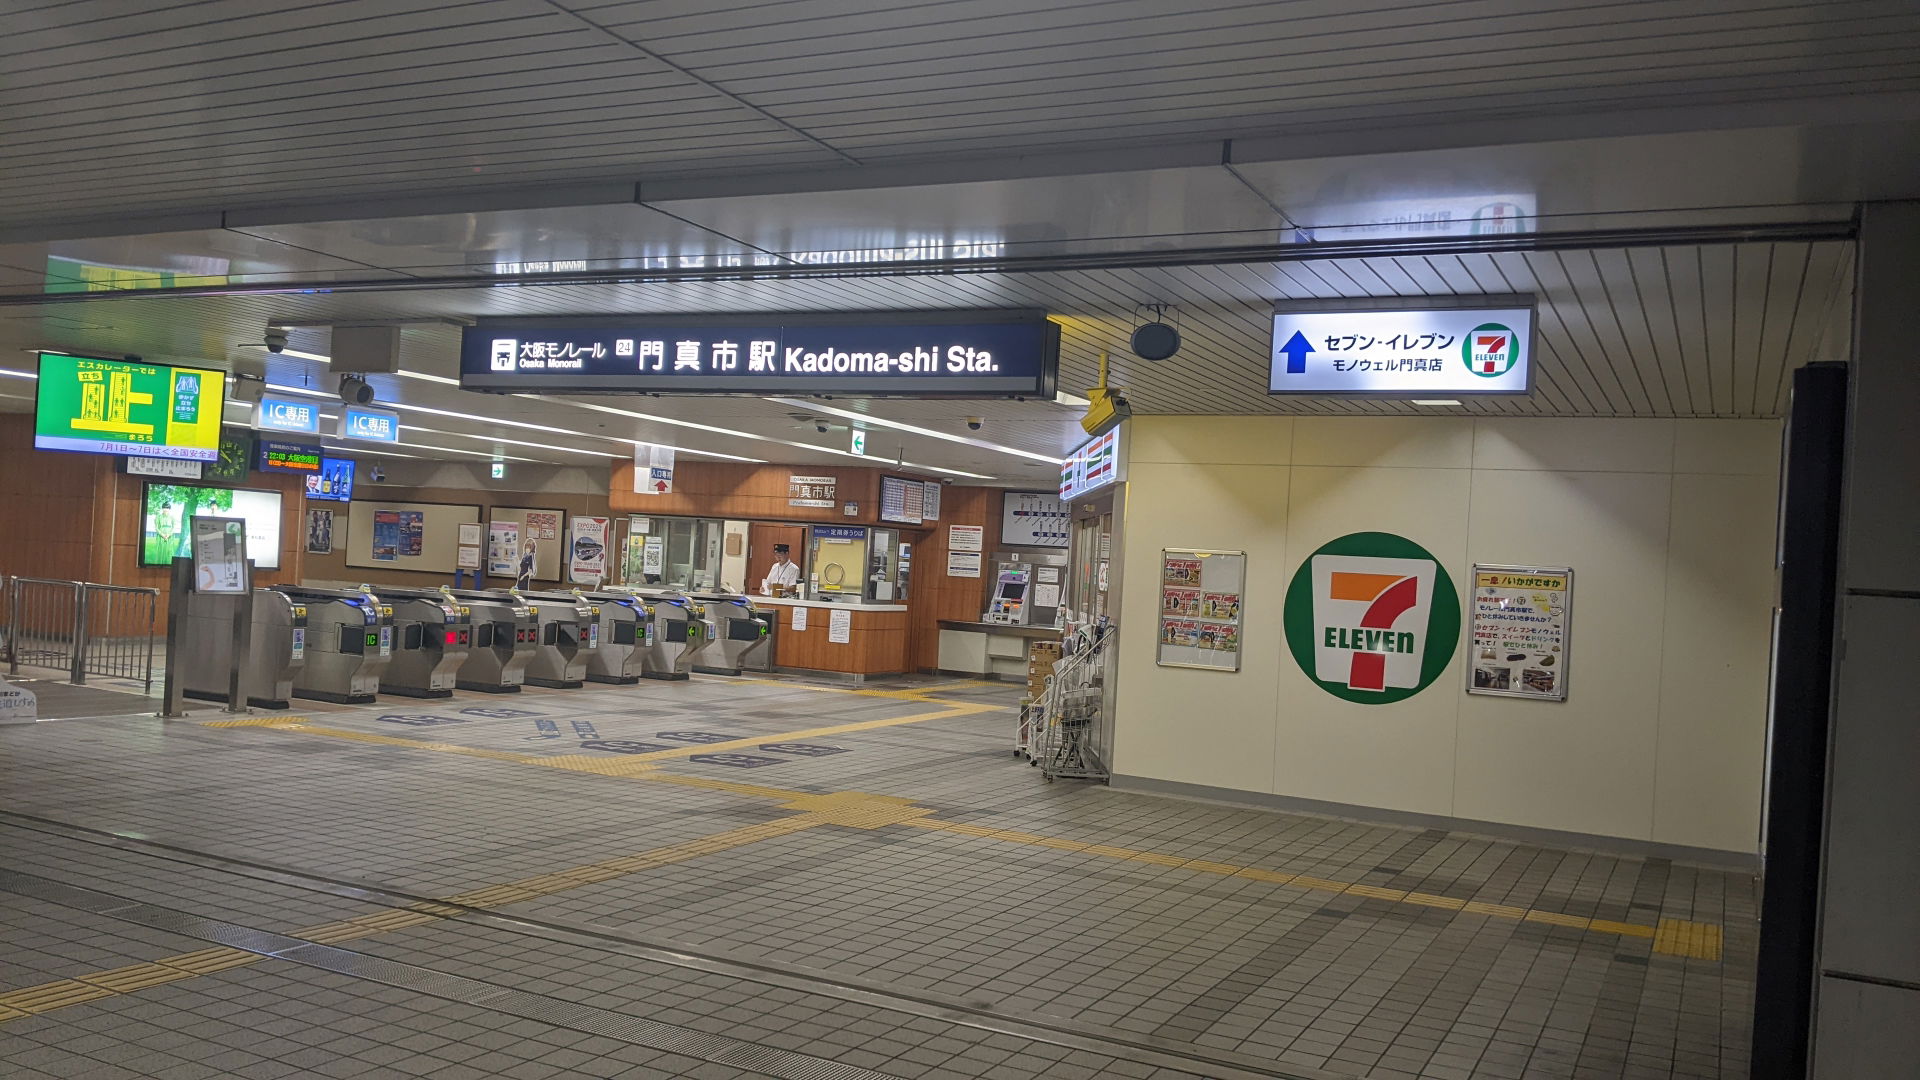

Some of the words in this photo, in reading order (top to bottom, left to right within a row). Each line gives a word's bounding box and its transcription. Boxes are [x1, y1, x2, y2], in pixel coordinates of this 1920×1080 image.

[519, 341, 607, 359] 大阪モノレール
[617, 342, 631, 353] 24
[638, 339, 776, 371] 門真市駅
[519, 358, 545, 369] Osaka
[547, 357, 582, 368] Monorail
[784, 346, 939, 372] Kadoma-shi
[946, 345, 999, 372] Sta.
[1332, 358, 1443, 373] モノウェル門真店
[77, 361, 156, 375] エスカレーターでは
[269, 403, 309, 422] IC専用
[353, 415, 389, 433] IC専用
[789, 484, 835, 499] 門真市駅
[367, 634, 376, 645] IC
